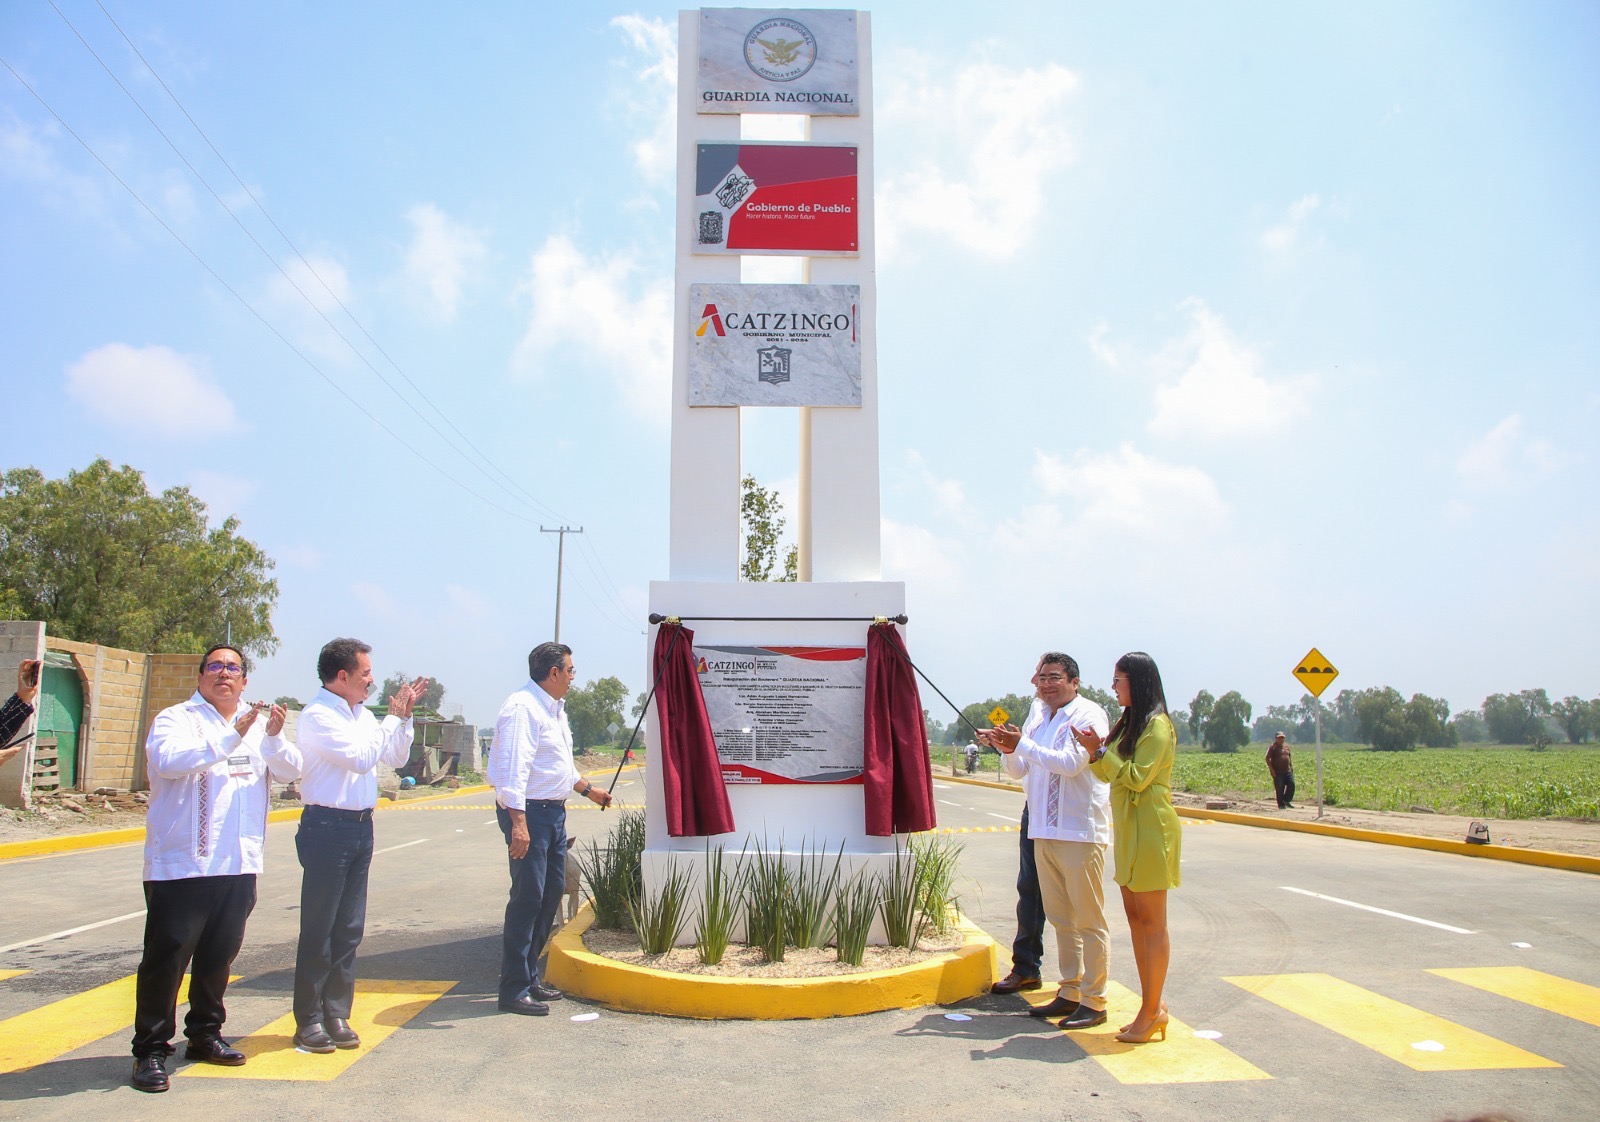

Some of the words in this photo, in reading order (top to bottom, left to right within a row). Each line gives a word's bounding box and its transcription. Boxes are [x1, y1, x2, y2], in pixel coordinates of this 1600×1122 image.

[749, 22, 778, 45] GUARDIA
[780, 22, 812, 46] NACIONAL
[758, 67, 785, 78] JUSTICIA
[703, 92, 771, 102] GUARDIA
[775, 92, 853, 103] NACIONAL
[746, 202, 795, 213] Gobierno
[797, 203, 811, 213] de
[813, 204, 851, 214] Puebla
[784, 213, 799, 221] Hacer
